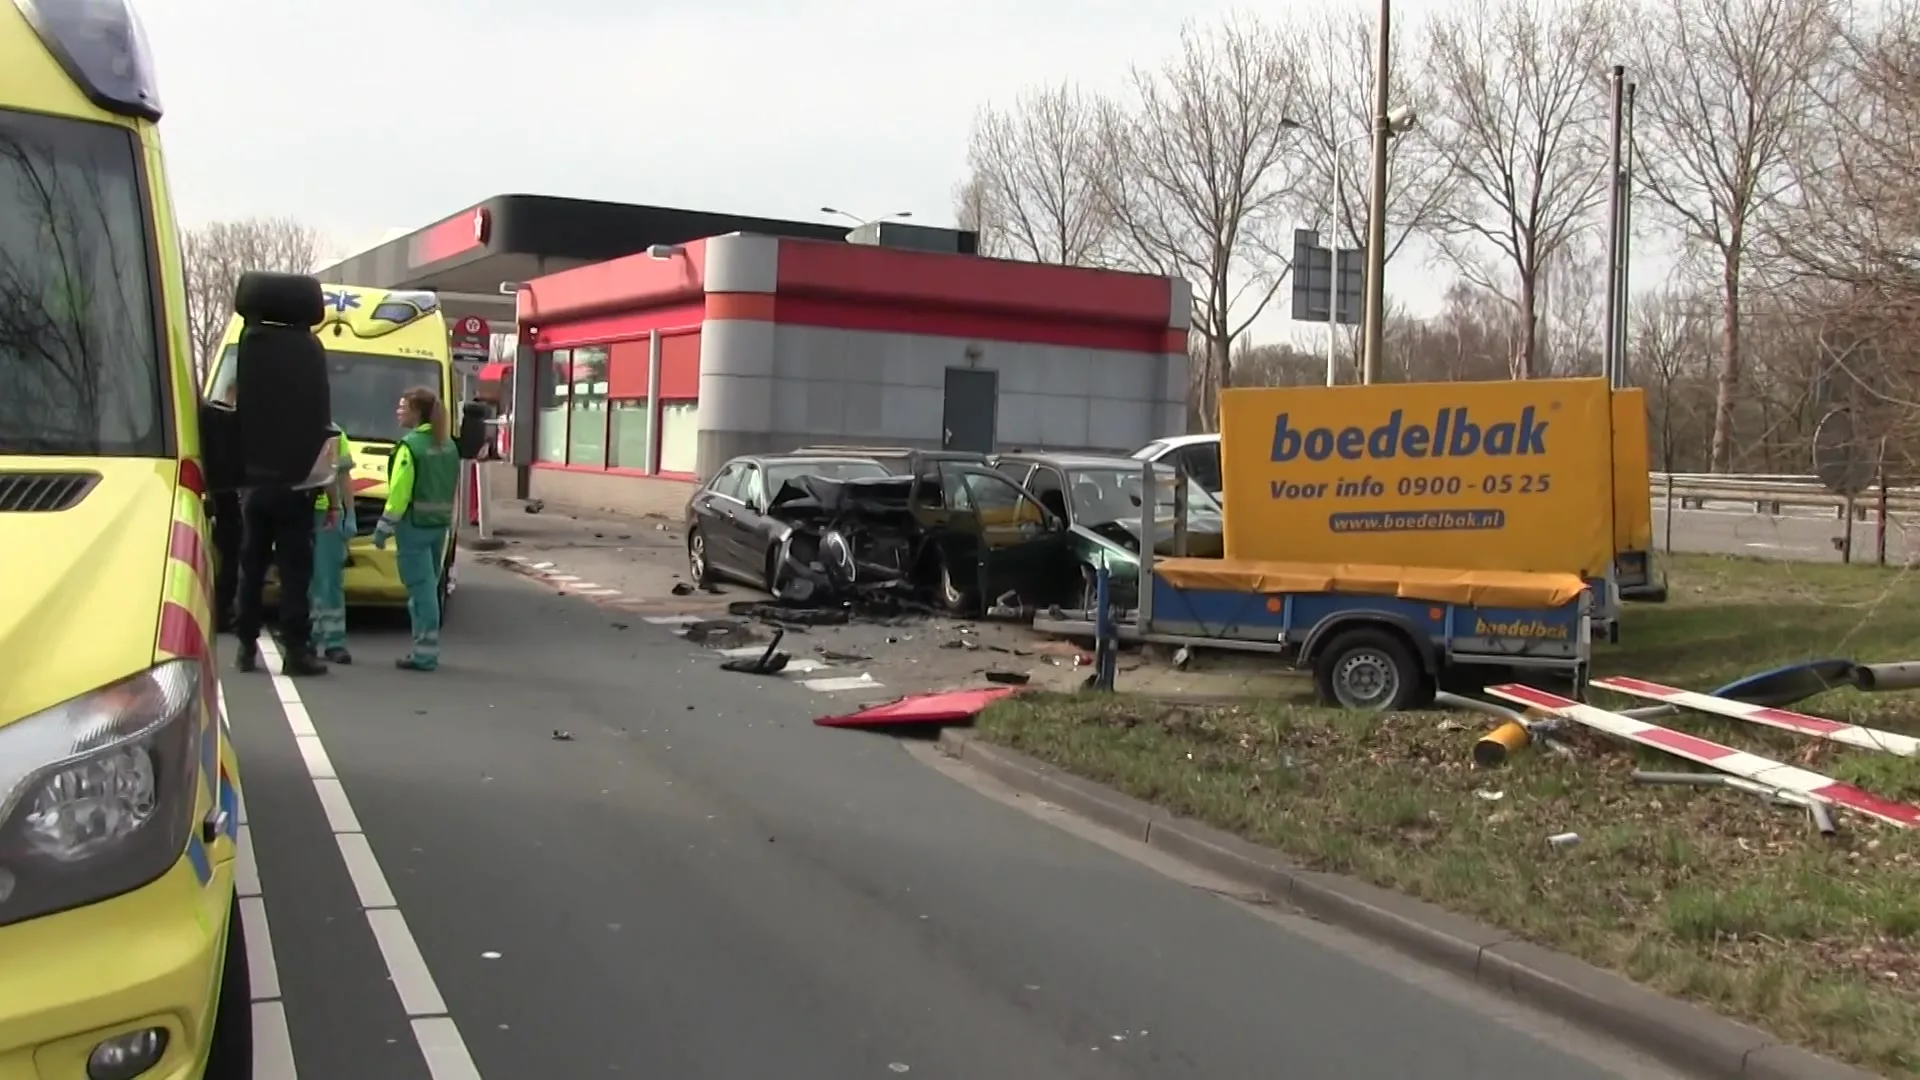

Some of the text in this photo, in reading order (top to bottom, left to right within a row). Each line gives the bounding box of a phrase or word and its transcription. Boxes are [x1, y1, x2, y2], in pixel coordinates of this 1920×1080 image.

[1270, 406, 1549, 462] boedelbak
[1270, 480, 1328, 499] Voor
[1335, 476, 1385, 497] info
[1398, 475, 1461, 496] 0900
[1334, 510, 1500, 529] www.boedelbak.nl
[1475, 616, 1568, 638] boedelbak
